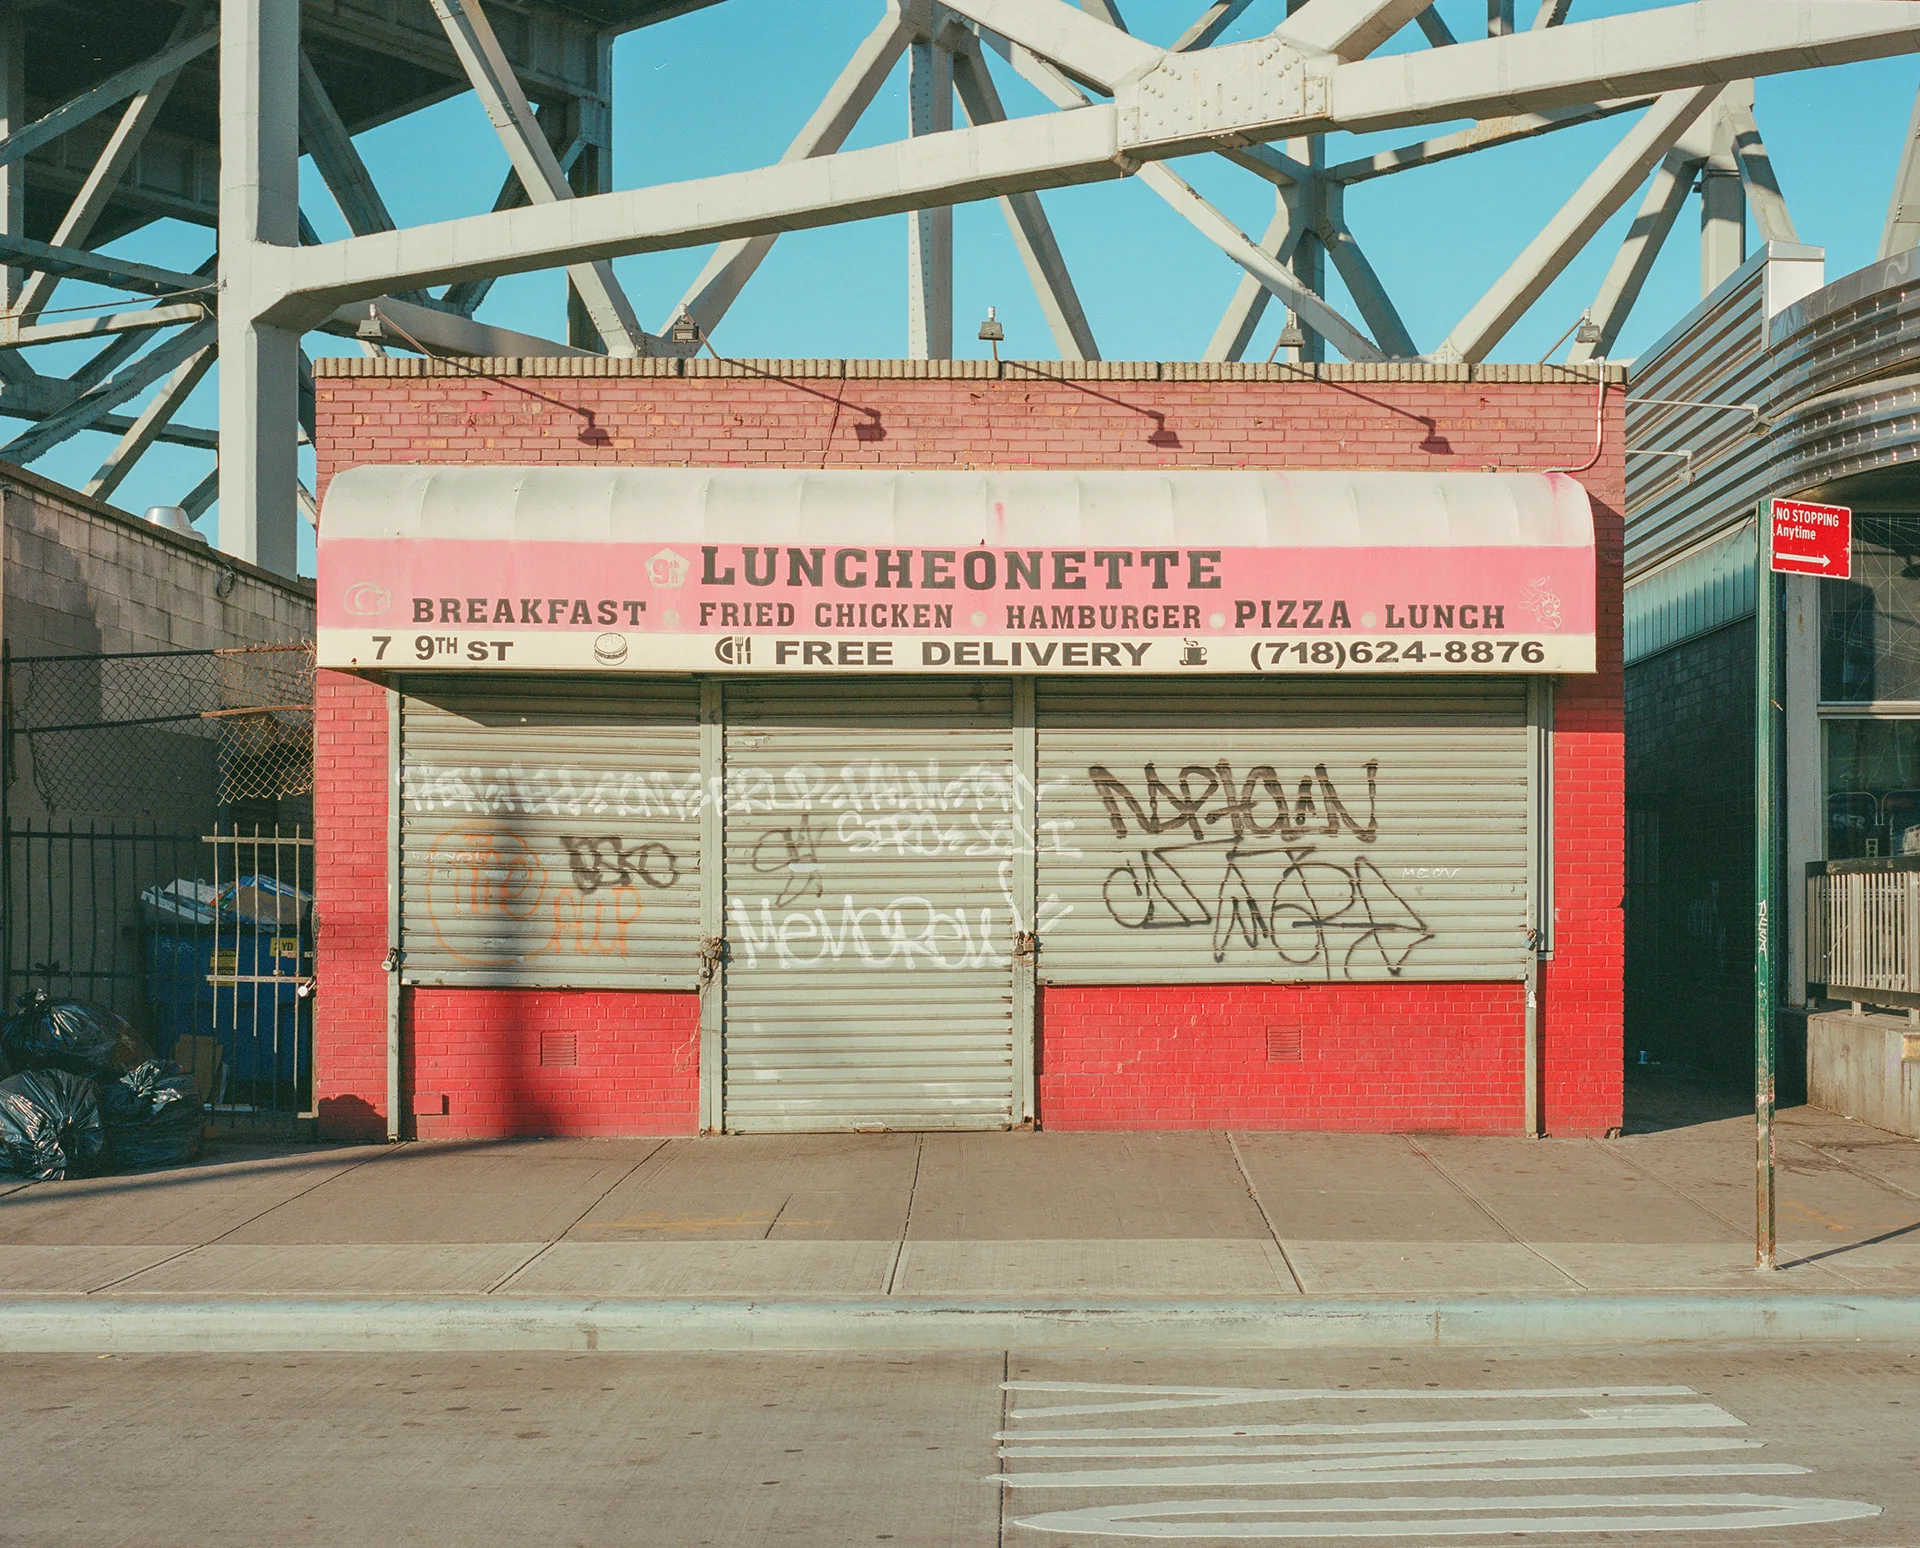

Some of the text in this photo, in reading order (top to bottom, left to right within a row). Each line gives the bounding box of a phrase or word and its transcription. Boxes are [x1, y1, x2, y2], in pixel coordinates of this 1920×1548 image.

[1776, 507, 1839, 527] NO STOPPING
[1776, 523, 1816, 540] Anytime
[701, 545, 1222, 590] LUNCHEONETTE
[412, 598, 646, 626] BREAKFAST
[700, 601, 1505, 629] FRIED CHICKEN HAMBURGER PIZZA LUNCH
[372, 637, 514, 661] 7 9TH ST
[775, 641, 1153, 666] FREE DELIVERY
[1250, 640, 1546, 669] (718)624-8876
[281, 942, 293, 951] YD
